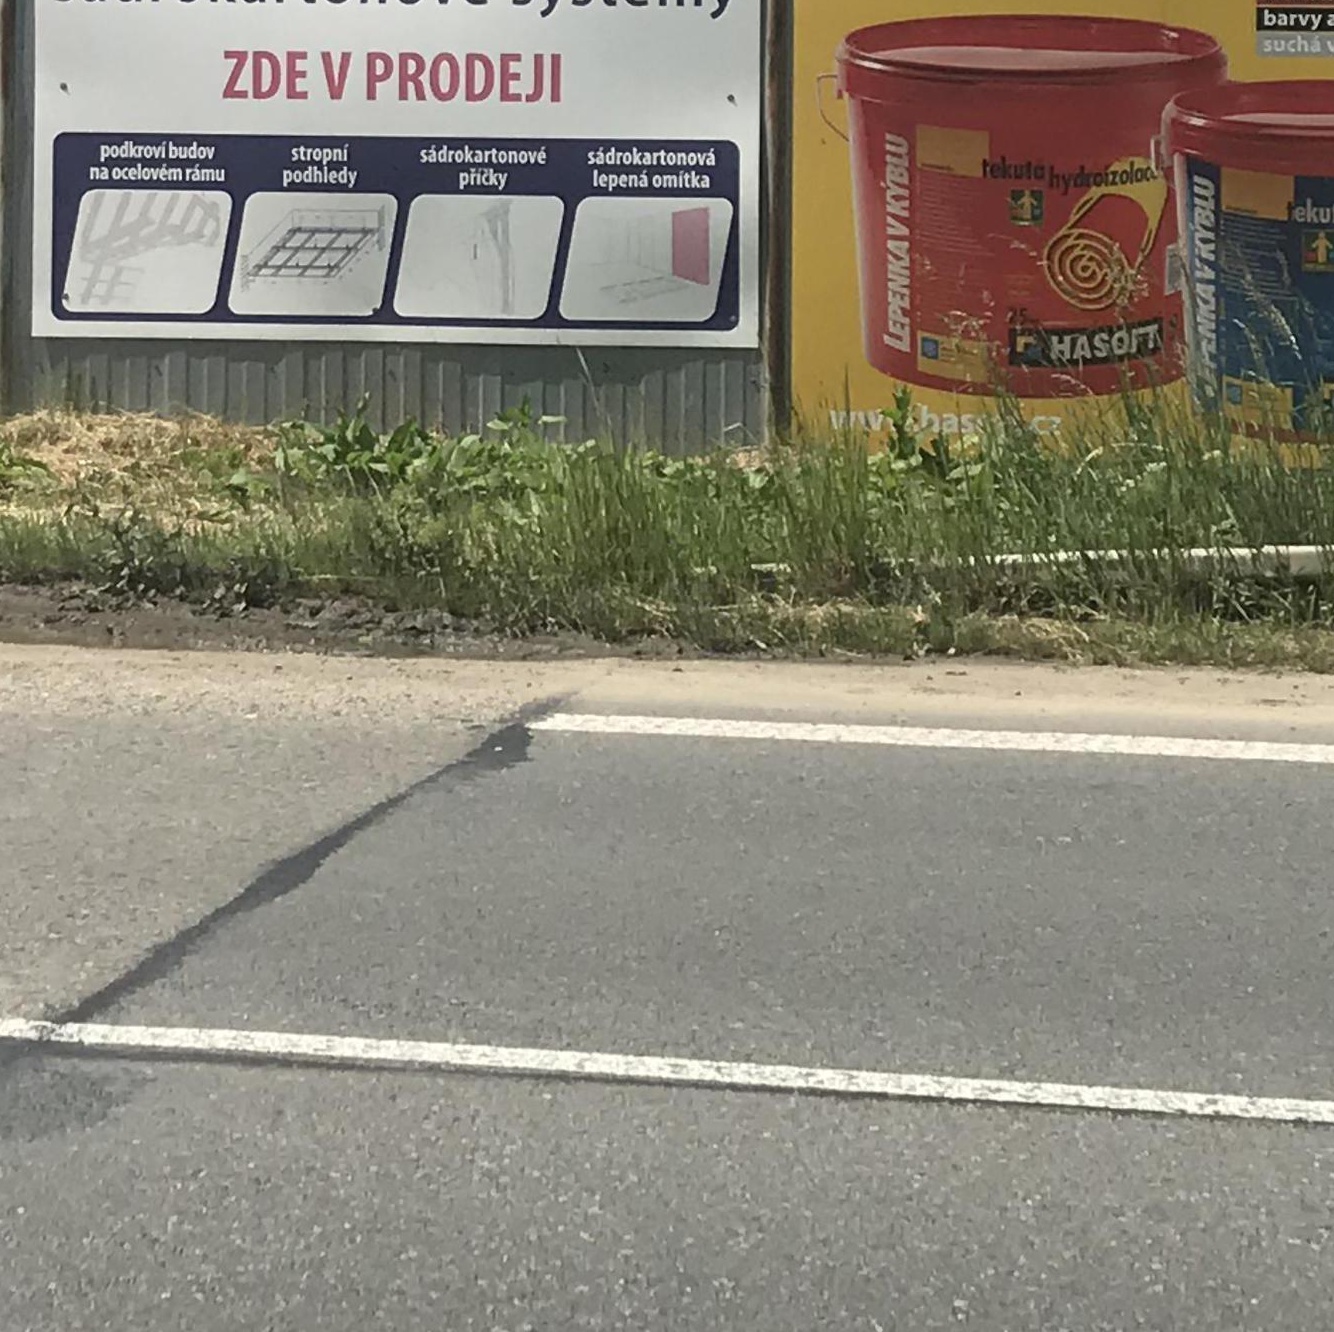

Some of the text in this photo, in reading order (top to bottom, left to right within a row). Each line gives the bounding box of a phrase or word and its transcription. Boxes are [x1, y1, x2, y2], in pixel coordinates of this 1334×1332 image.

[1263, 10, 1323, 31] barvy
[1263, 35, 1322, 54] suchá
[222, 49, 563, 104] ZDE V PRODEJI
[99, 140, 215, 163] podkroví budov
[290, 143, 349, 166] stropní
[419, 145, 547, 166] sádrokartonové
[587, 147, 716, 167] sádrokartonová
[89, 163, 226, 183] na ocelovém rámu
[282, 165, 358, 188] podhledy
[458, 168, 508, 191] příčky
[592, 169, 711, 192] lepená omítka
